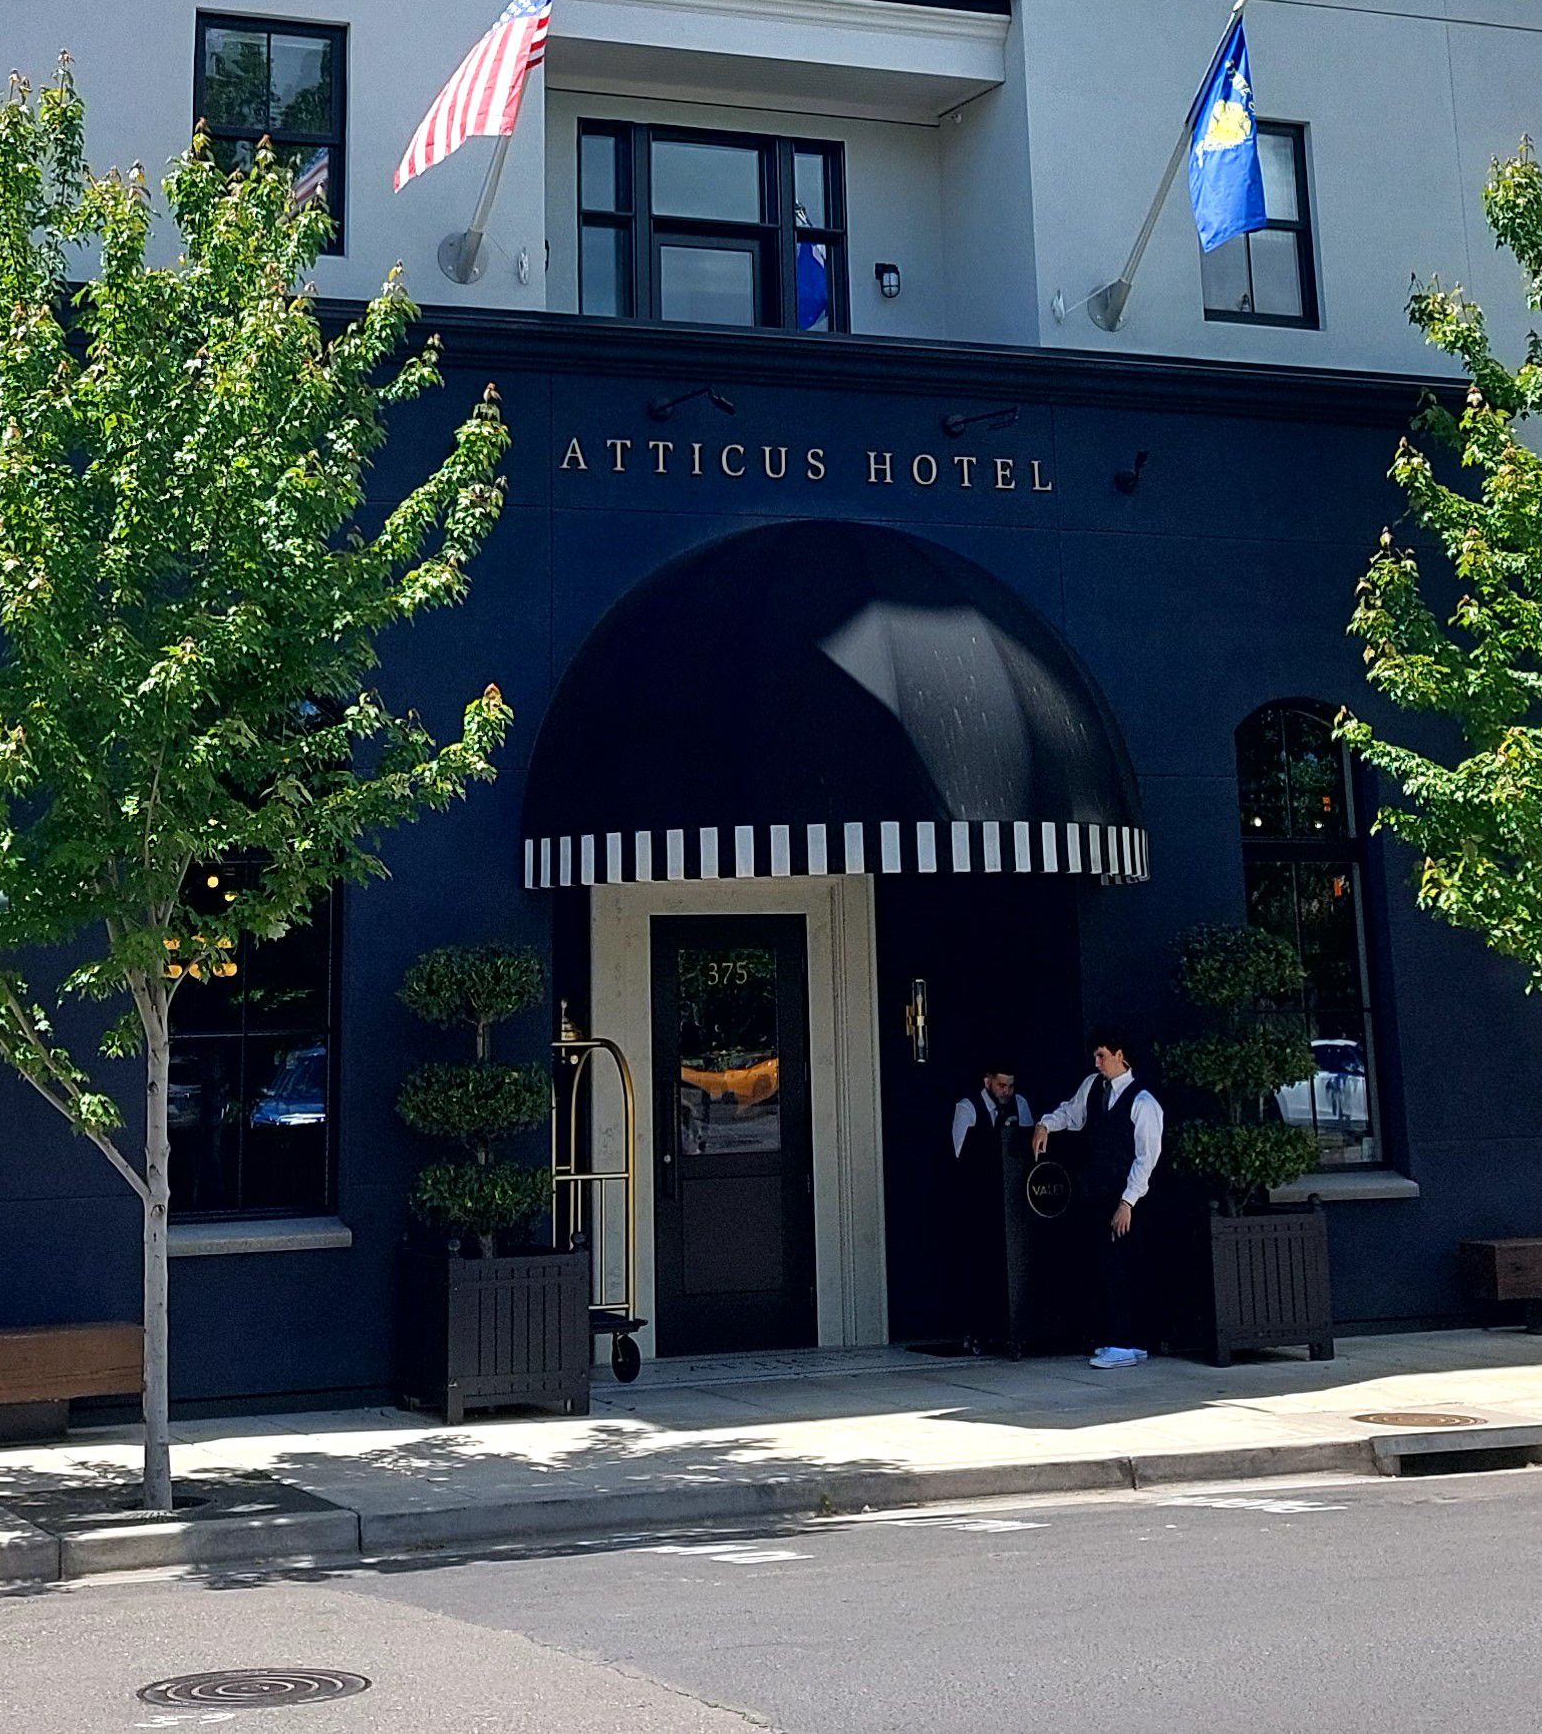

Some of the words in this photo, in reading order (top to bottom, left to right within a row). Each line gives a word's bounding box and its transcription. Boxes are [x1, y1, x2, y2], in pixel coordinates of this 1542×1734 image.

[560, 437, 826, 481] ATTICUS
[866, 451, 1053, 491] HOTEL
[708, 960, 748, 985] 375
